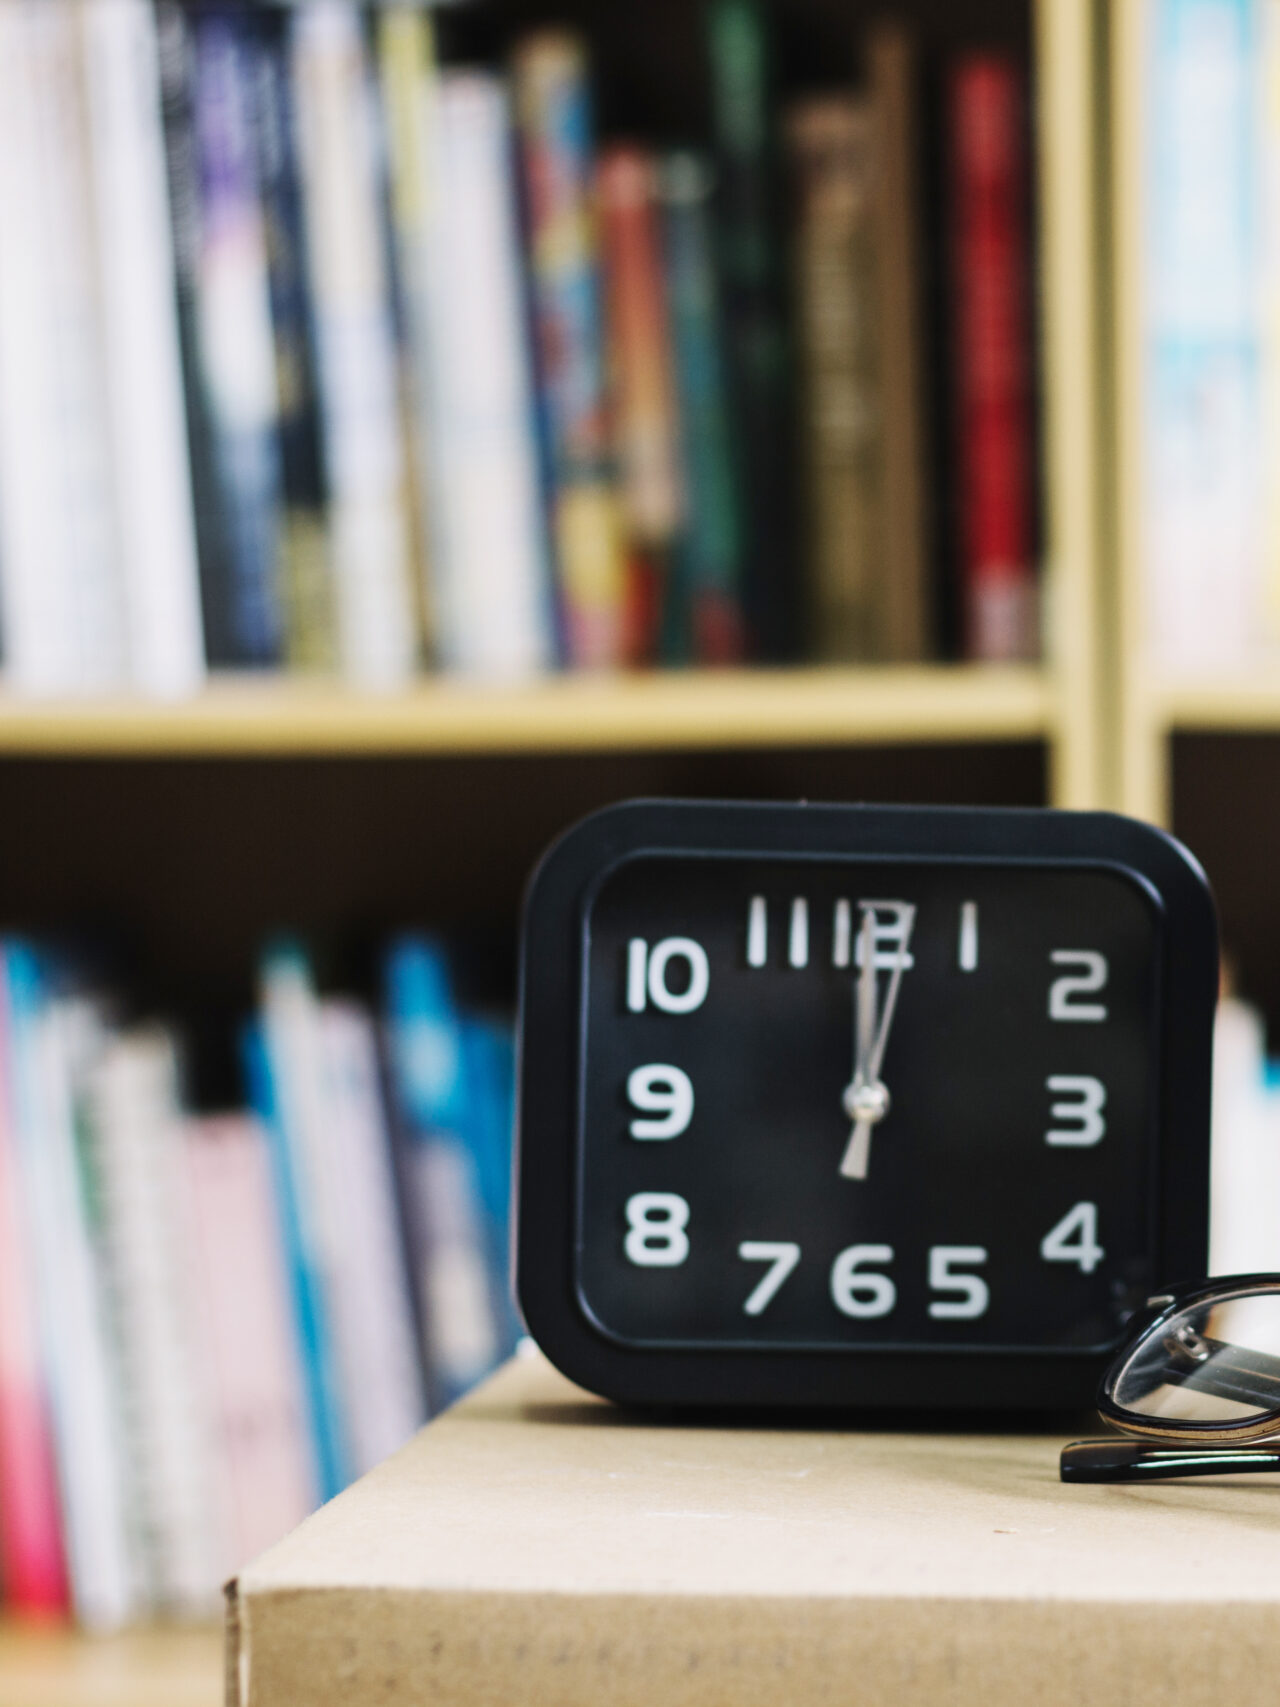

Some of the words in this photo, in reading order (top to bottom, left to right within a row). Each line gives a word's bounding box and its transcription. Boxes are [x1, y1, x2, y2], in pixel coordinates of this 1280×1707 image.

[748, 896, 809, 969] 11
[833, 898, 916, 969] 12
[959, 901, 978, 971] 1
[627, 936, 710, 1014] 10
[1048, 950, 1107, 1020] 2
[627, 1063, 695, 1140] 9
[1045, 1075, 1106, 1146] 3
[624, 1191, 690, 1267] 8
[1041, 1202, 1104, 1273] 4
[739, 1240, 801, 1315] 7
[830, 1244, 896, 1318] 6
[929, 1245, 989, 1318] 5
